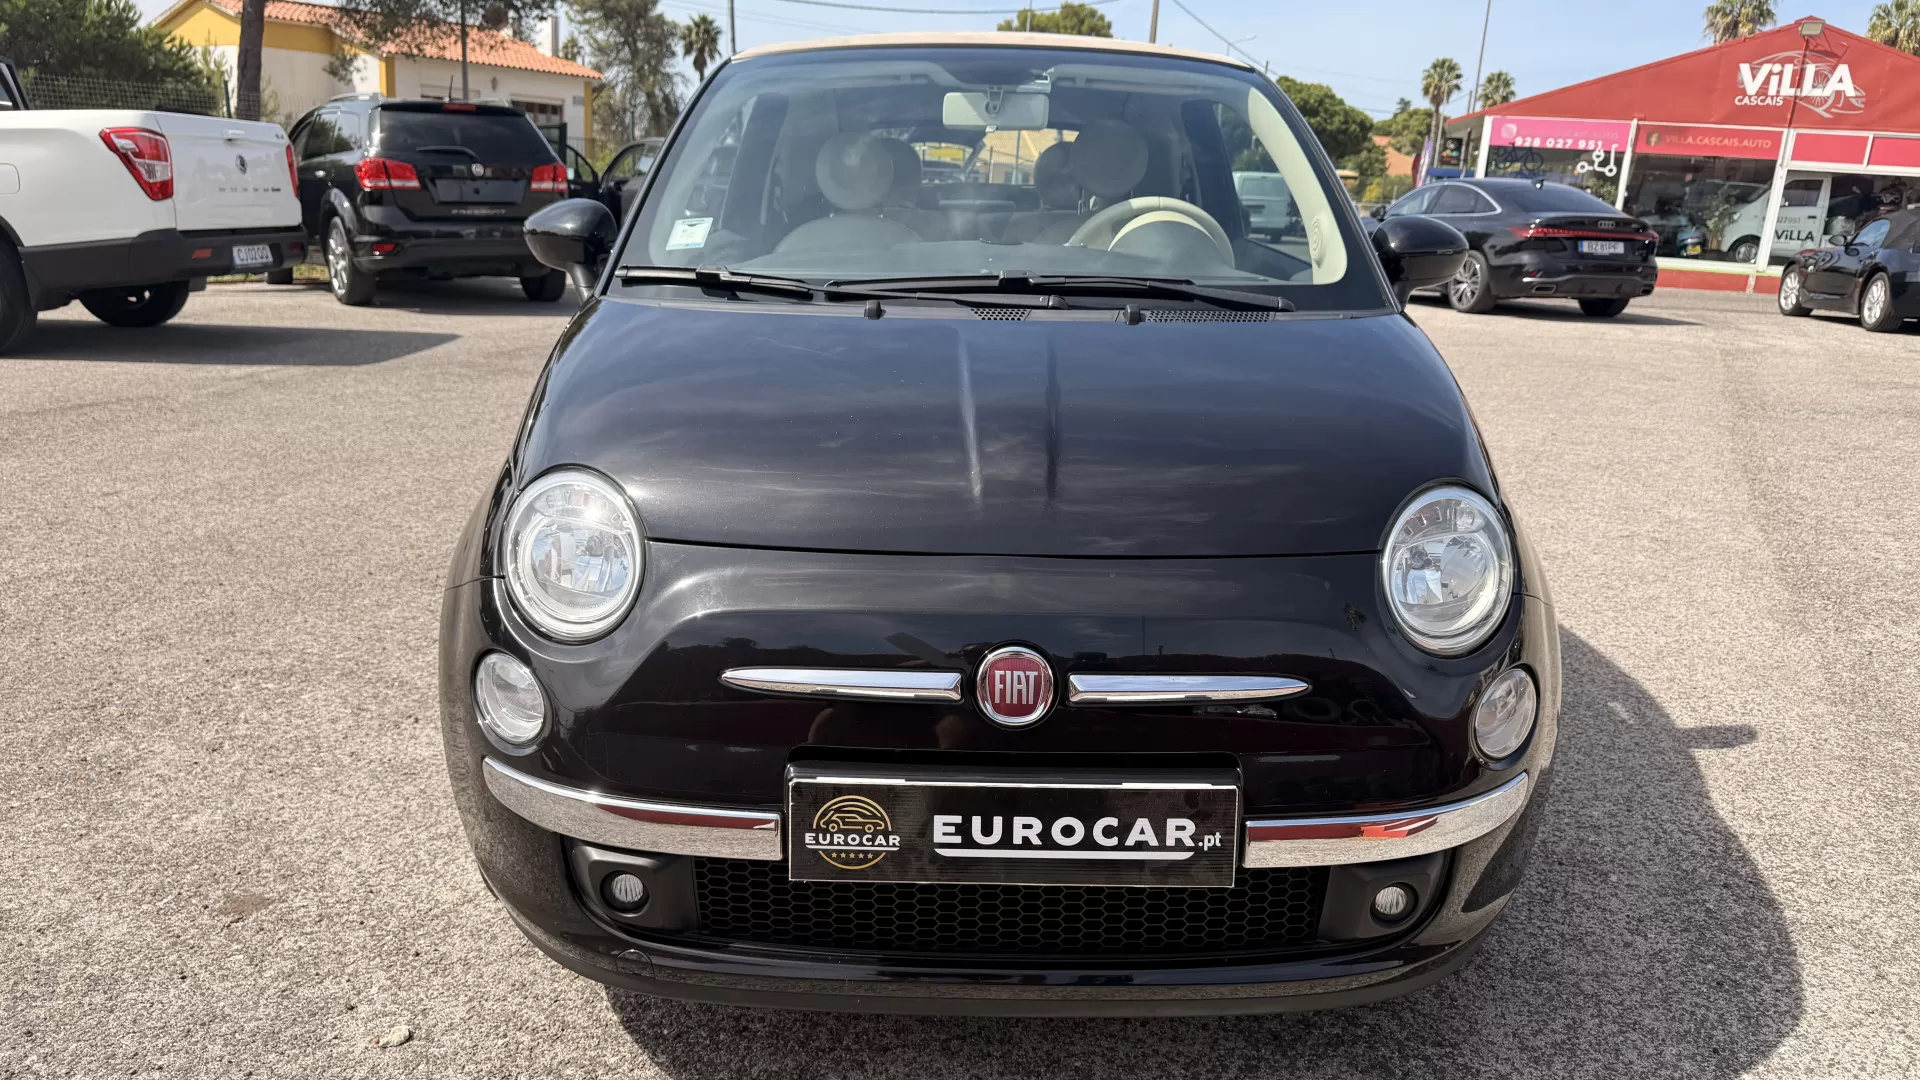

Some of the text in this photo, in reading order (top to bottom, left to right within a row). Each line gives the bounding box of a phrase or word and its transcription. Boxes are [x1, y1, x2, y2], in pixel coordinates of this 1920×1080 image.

[1735, 96, 1783, 106] CASCAIS
[1514, 136, 1603, 150] 928 027 951
[1665, 135, 1771, 148] VILLA.CASCAIS.AUTO
[994, 670, 1038, 705] FIAT
[804, 832, 901, 846] EUROCAR
